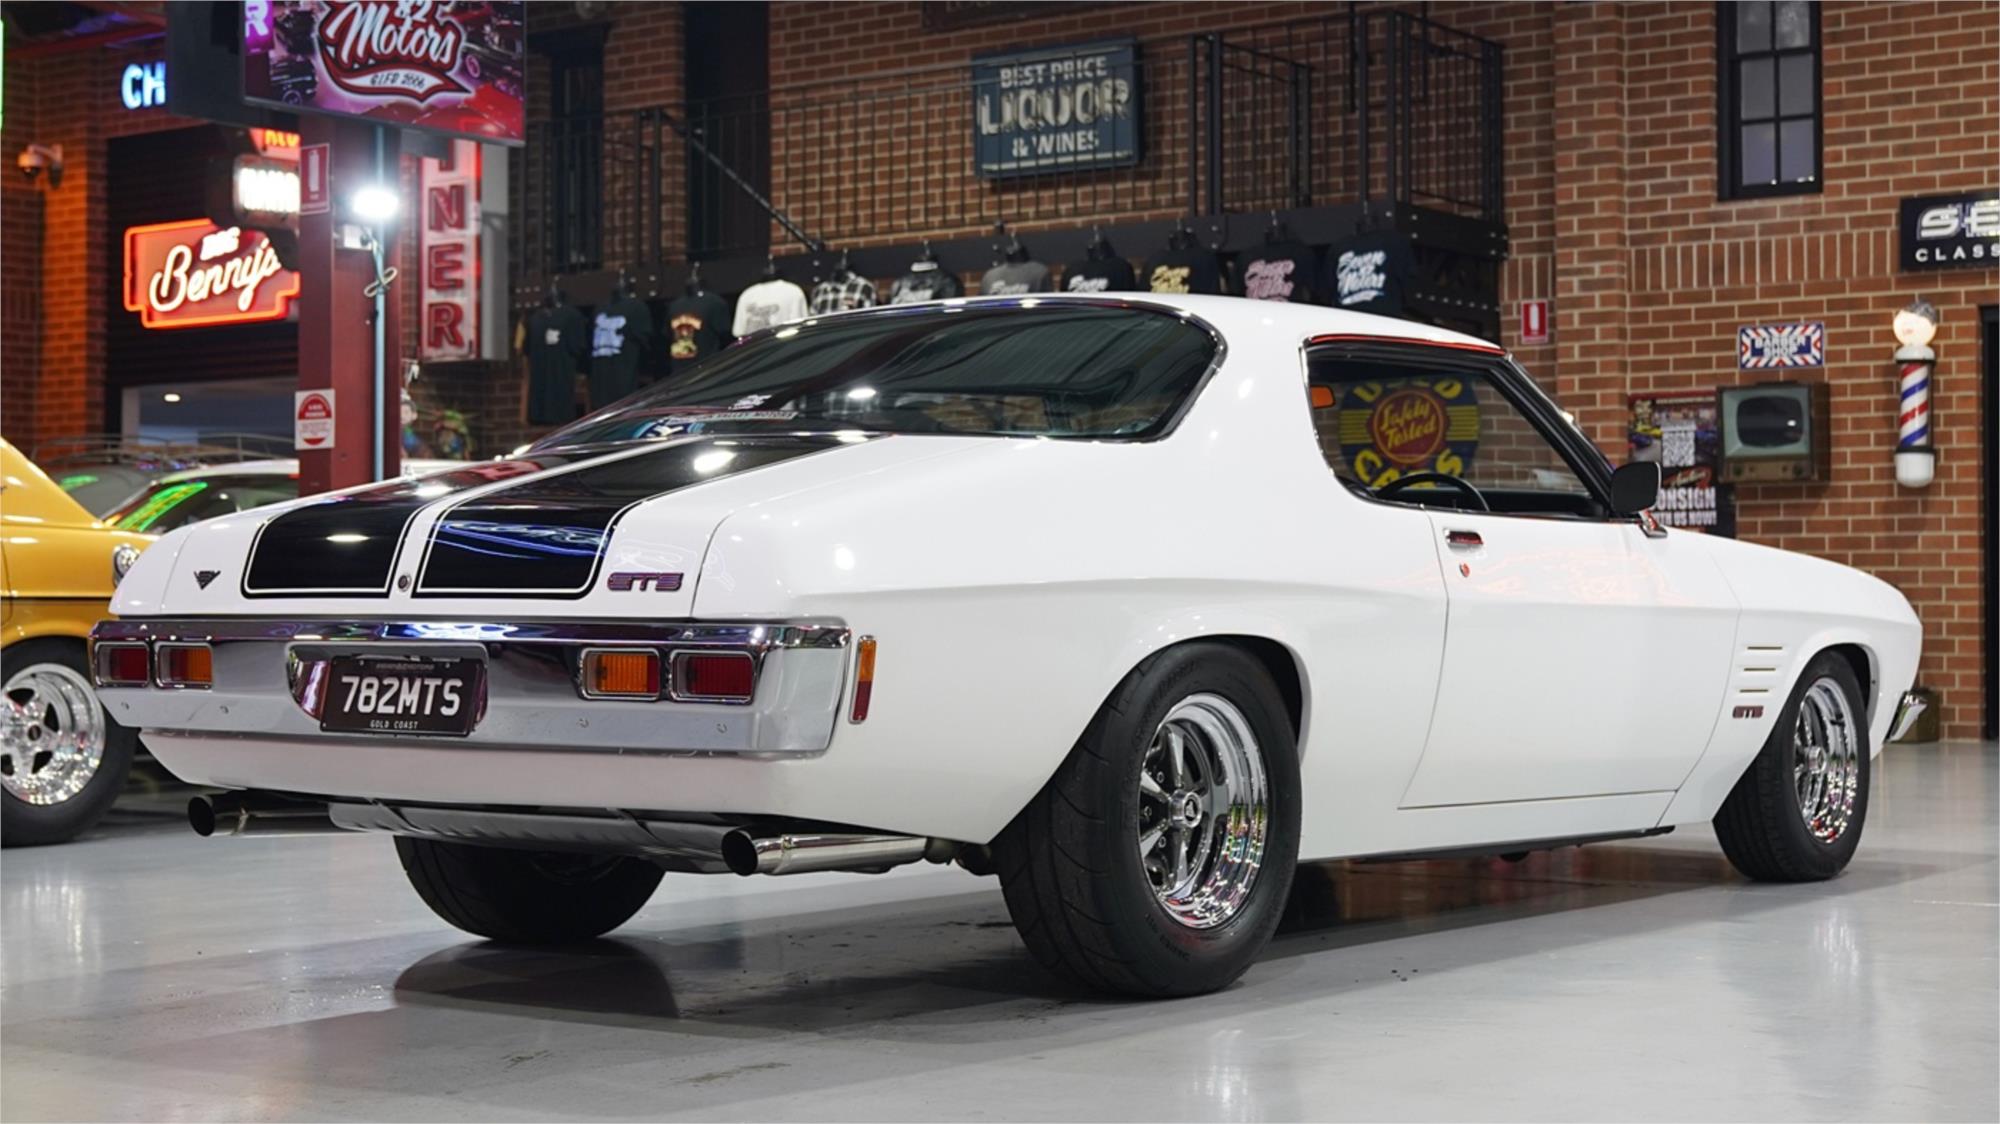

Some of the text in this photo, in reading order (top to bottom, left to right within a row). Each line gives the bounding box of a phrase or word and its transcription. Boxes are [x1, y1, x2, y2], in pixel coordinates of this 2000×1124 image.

[326, 2, 456, 64] Motors
[122, 62, 166, 109] CH
[1001, 57, 1107, 88] BEST PRICE
[977, 78, 1129, 135] LIQUOR
[1012, 130, 1099, 157] & WINES
[1353, 377, 1463, 402] UD
[1386, 414, 1437, 449] Tested
[1656, 487, 1716, 510] ONSIGN
[607, 572, 684, 592] GTS
[341, 675, 463, 716] 782MTS
[369, 719, 418, 730] GOLD COAST
